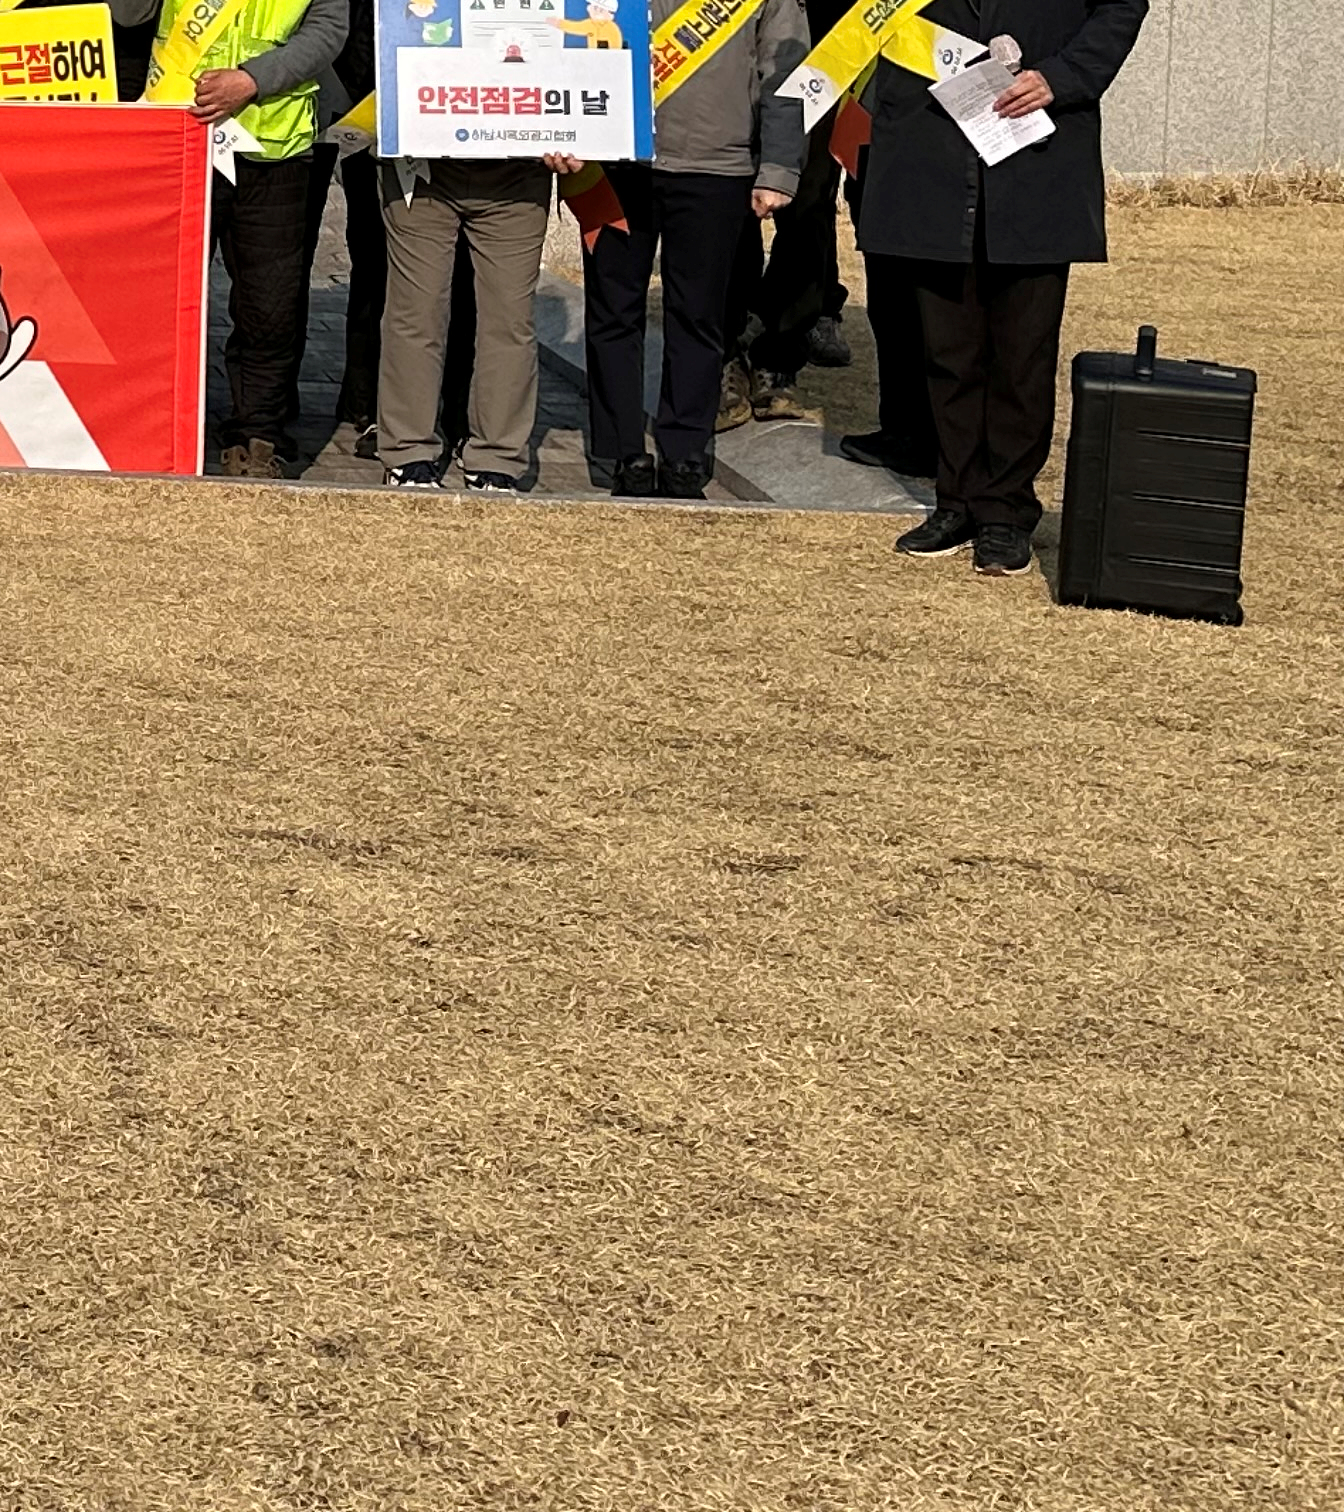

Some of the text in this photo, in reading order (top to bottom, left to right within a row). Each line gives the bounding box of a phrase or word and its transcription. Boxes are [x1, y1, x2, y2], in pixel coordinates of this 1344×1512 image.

[0, 38, 106, 85] 근절하여
[417, 86, 610, 116] 안전점검의 날
